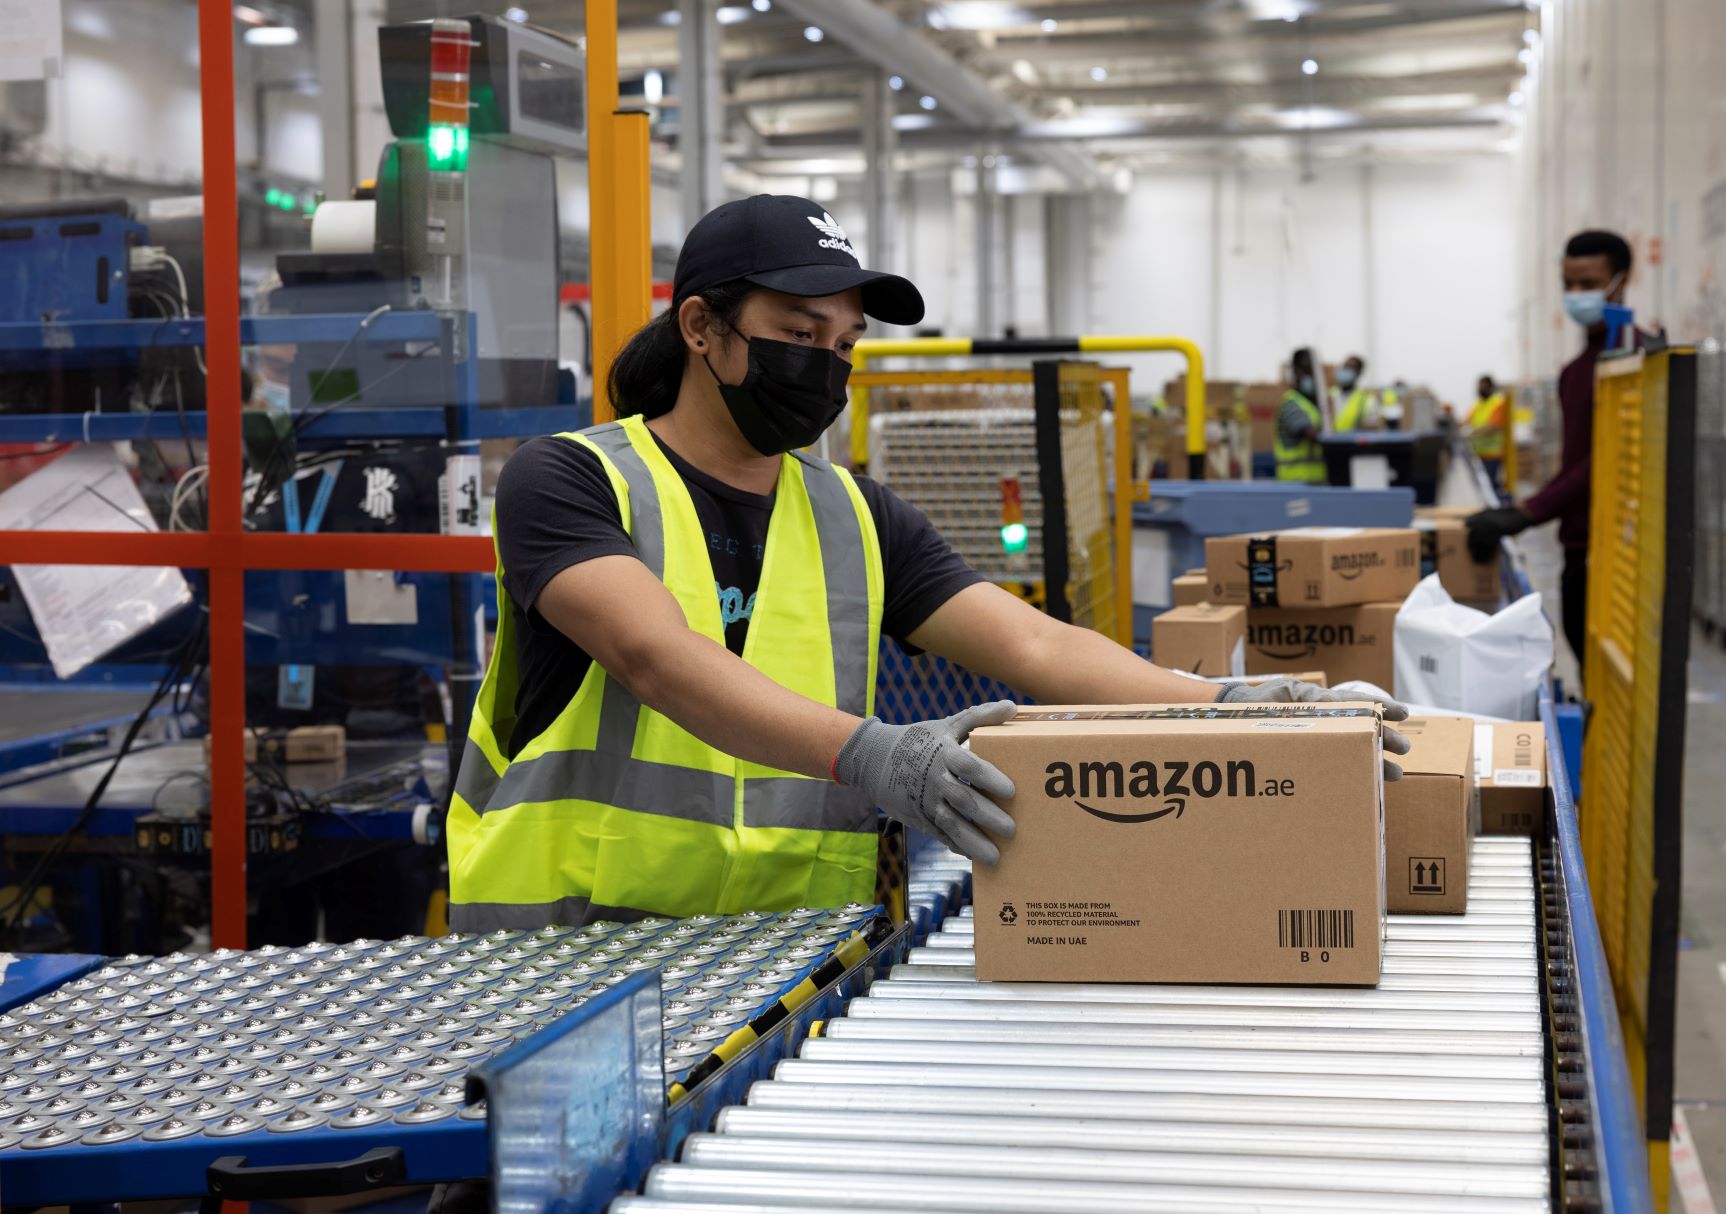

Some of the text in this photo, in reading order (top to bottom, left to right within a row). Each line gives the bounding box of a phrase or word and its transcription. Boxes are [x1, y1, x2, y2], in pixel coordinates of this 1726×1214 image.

[1044, 759, 1295, 798] amazon.ae
[1026, 902, 1111, 910] THIS BOX IS MADE FROM
[1026, 919, 1141, 927] TO PROTECT OUR ENVIRONMENT
[1027, 937, 1087, 945] MADE IN UAE
[1300, 951, 1310, 963] B
